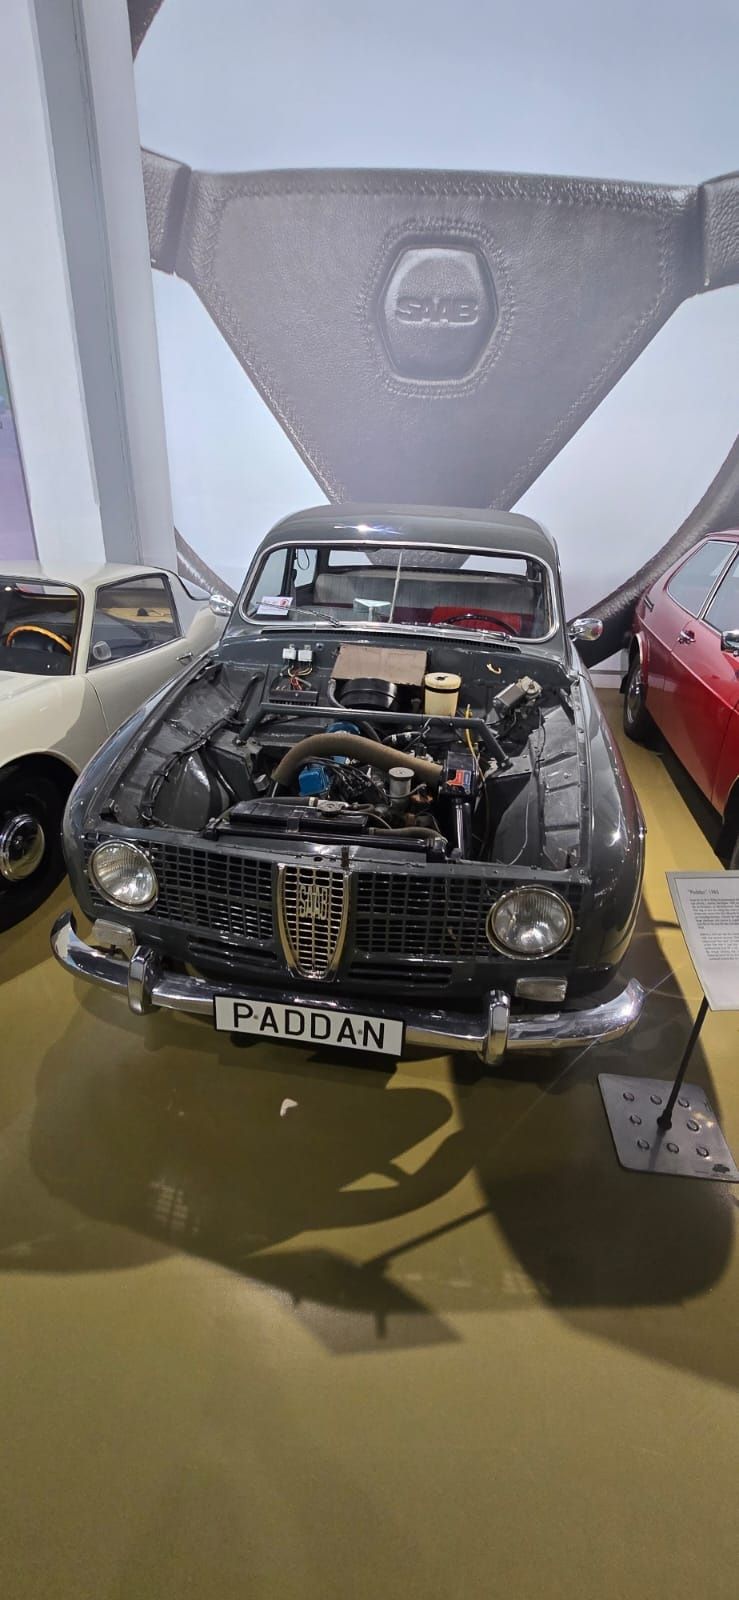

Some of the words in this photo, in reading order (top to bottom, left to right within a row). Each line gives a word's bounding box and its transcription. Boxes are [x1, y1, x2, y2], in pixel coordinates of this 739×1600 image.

[397, 297, 479, 325] SAAB
[300, 885, 328, 920] SAAB
[233, 1002, 385, 1049] PADDAN
